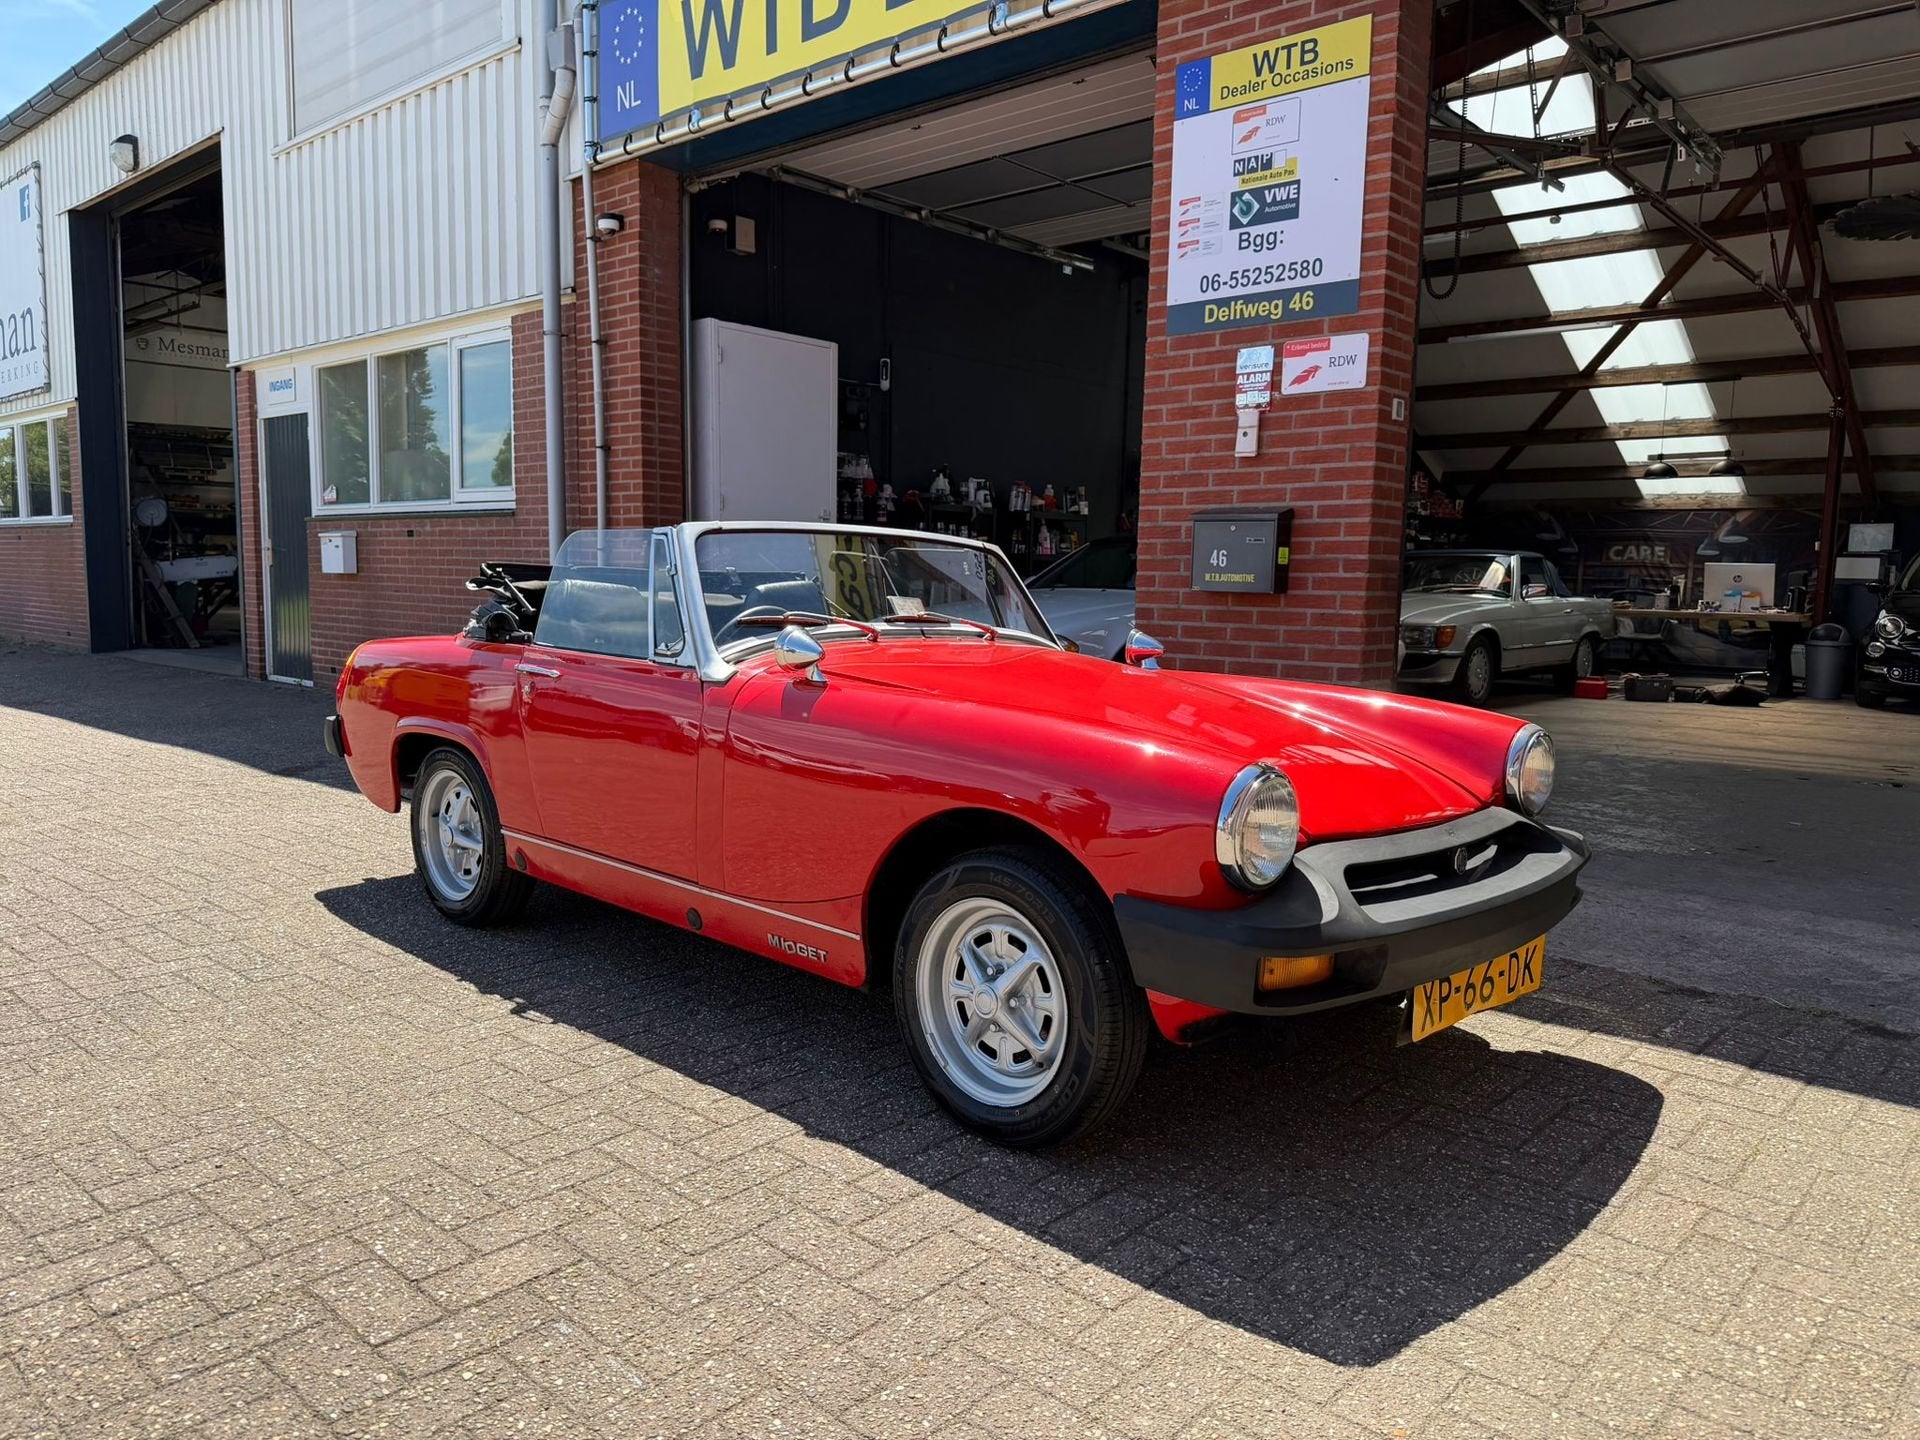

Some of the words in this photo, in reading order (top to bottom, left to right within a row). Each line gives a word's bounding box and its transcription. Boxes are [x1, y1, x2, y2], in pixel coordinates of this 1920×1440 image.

[1252, 37, 1319, 78] WTB
[1220, 79, 1267, 101] Dealer
[1271, 57, 1354, 88] Occasions
[617, 79, 641, 112] NL
[1184, 97, 1200, 112] NL
[1265, 114, 1286, 127] RDW
[1241, 174, 1268, 185] Nationale
[1269, 171, 1283, 180] Auto
[1264, 184, 1298, 204] VWE
[1264, 202, 1296, 213] Automotive
[1238, 229, 1285, 253] Bgg:
[1200, 257, 1323, 294] 06-55252580
[1204, 297, 1283, 325] Delfweg
[1289, 290, 1314, 312] 46
[0, 306, 37, 361] an
[1329, 353, 1358, 368] RDW
[269, 378, 293, 393] INGANG
[1237, 372, 1271, 385] ALARM
[1210, 549, 1228, 568] 46
[1609, 545, 1665, 560] CARE
[767, 933, 828, 964] MIDGET
[1421, 944, 1538, 1032] XP-66-DK
